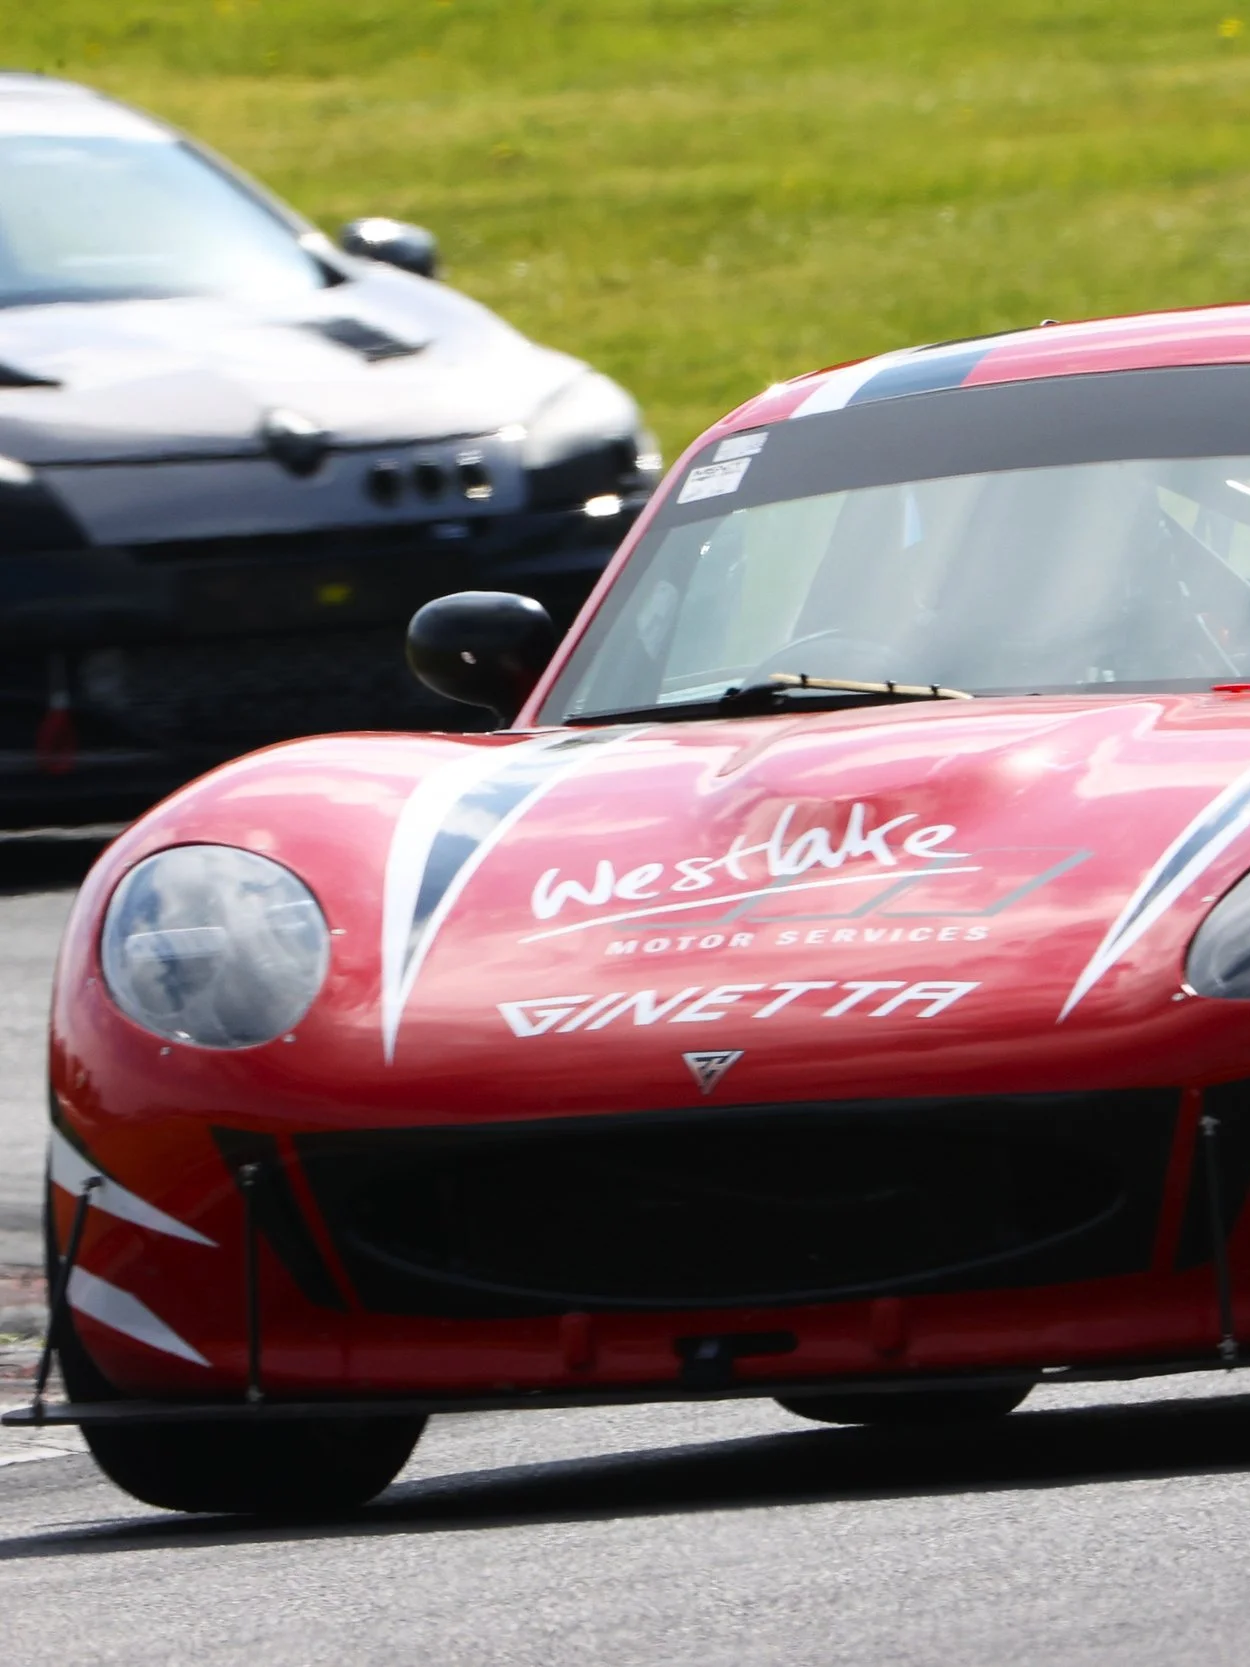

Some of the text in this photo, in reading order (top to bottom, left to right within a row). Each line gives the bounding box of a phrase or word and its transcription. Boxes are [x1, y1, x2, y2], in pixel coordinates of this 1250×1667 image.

[604, 926, 990, 956] MOTOR SERVICES
[497, 981, 982, 1037] GINETTA
